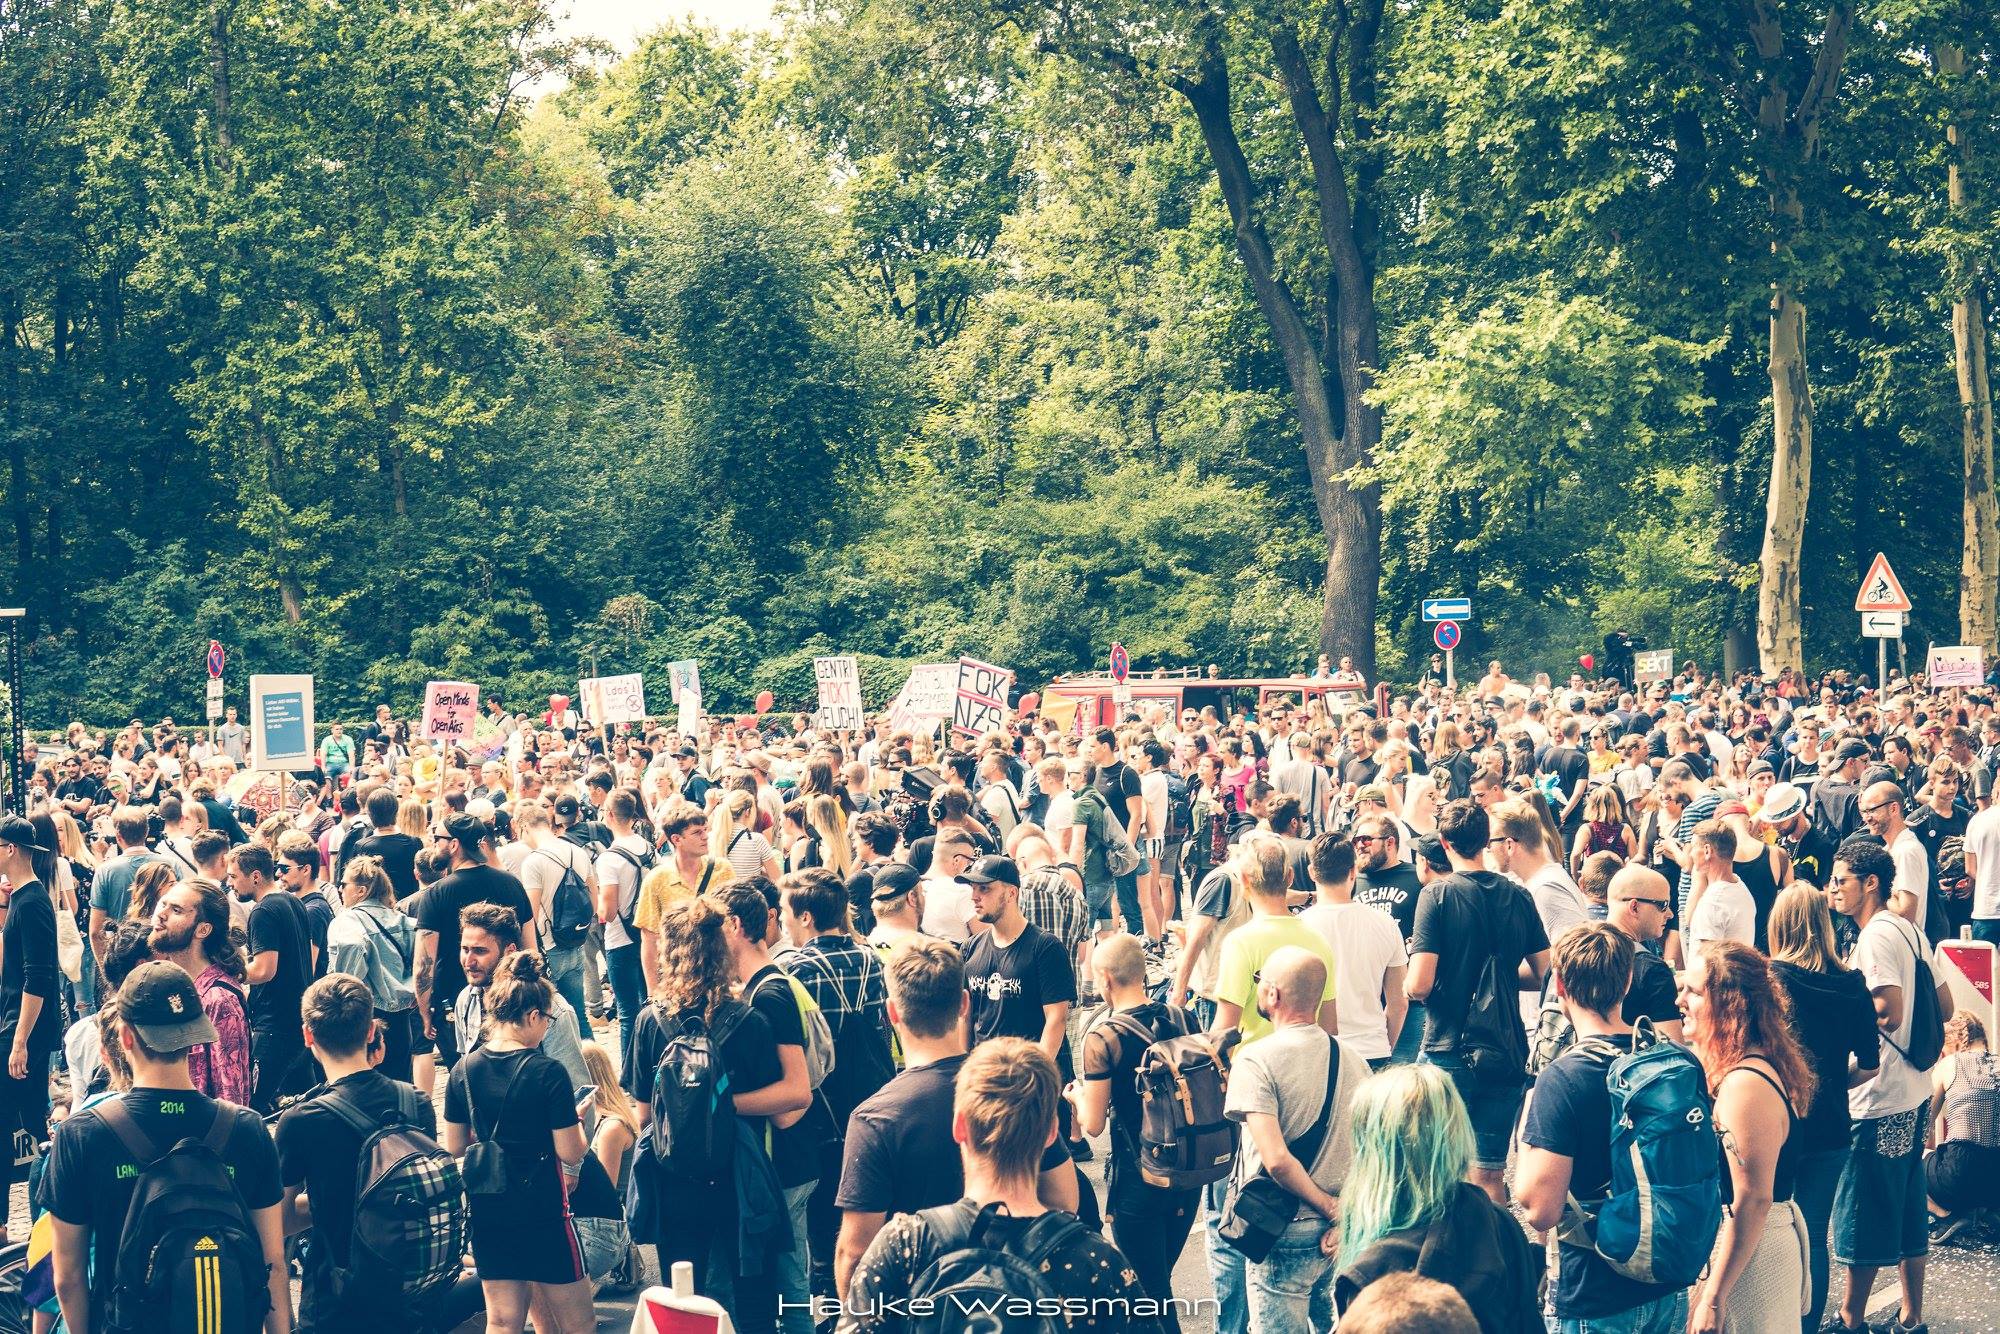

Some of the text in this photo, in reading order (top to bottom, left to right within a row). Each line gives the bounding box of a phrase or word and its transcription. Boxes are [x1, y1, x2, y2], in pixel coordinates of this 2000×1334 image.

[958, 662, 1007, 703] FCK
[435, 691, 471, 707] Open Minds
[447, 706, 457, 719] for
[821, 706, 860, 730] EUCH!
[953, 695, 1003, 734] NZS
[431, 718, 449, 734] Open
[1352, 886, 1409, 904] TECHNO
[160, 1101, 185, 1115] 2014
